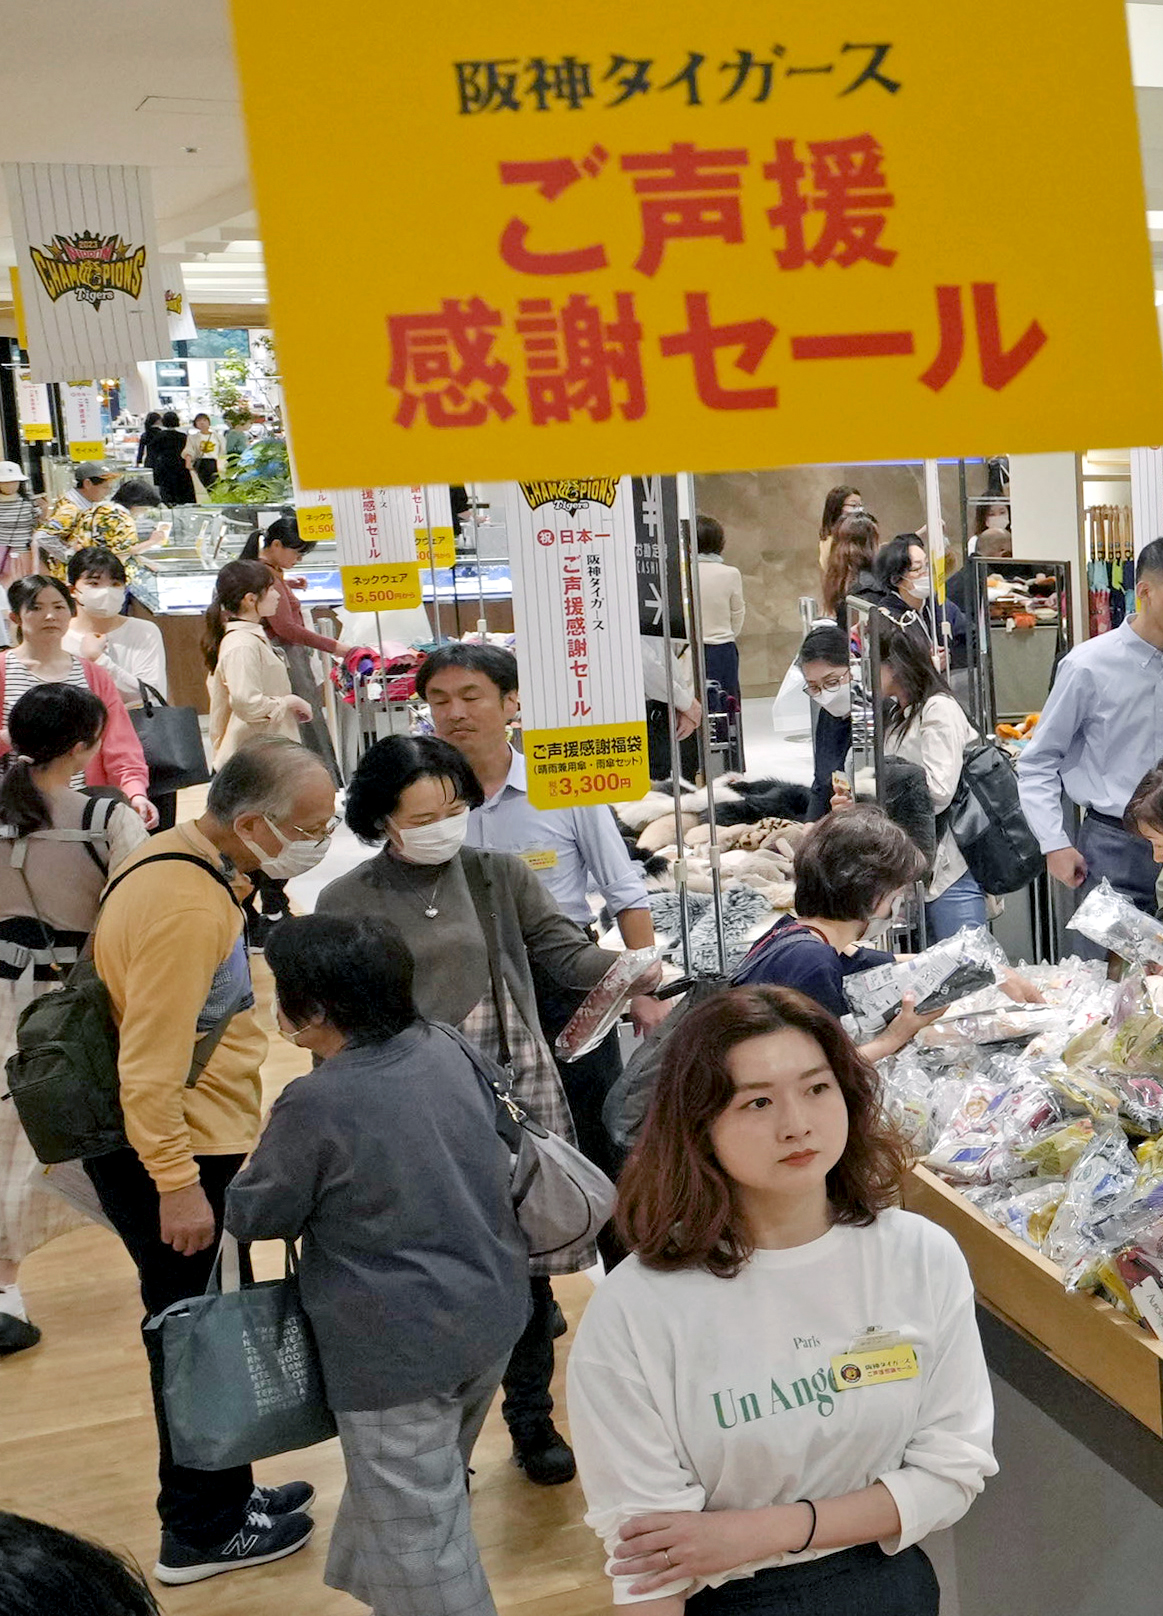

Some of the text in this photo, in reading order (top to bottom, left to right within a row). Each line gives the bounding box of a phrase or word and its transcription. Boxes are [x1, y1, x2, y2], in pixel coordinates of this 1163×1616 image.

[454, 42, 902, 115] 阪神タイガース
[498, 133, 899, 277] ご声援
[75, 288, 114, 302] Tigers
[386, 283, 1048, 428] 感謝セール
[554, 499, 590, 512] Tigers
[560, 528, 610, 544] 日本一
[635, 543, 668, 559] お勘定
[352, 573, 408, 586] ネックウェア
[636, 561, 668, 575] CASHI
[587, 554, 605, 632] 阪神タイガース
[563, 555, 591, 717] ご声援感謝セール
[533, 735, 642, 760] ご声援感謝福袋
[560, 772, 631, 797] 3,300円
[793, 1335, 821, 1351] Paris
[709, 1388, 762, 1430] Un
